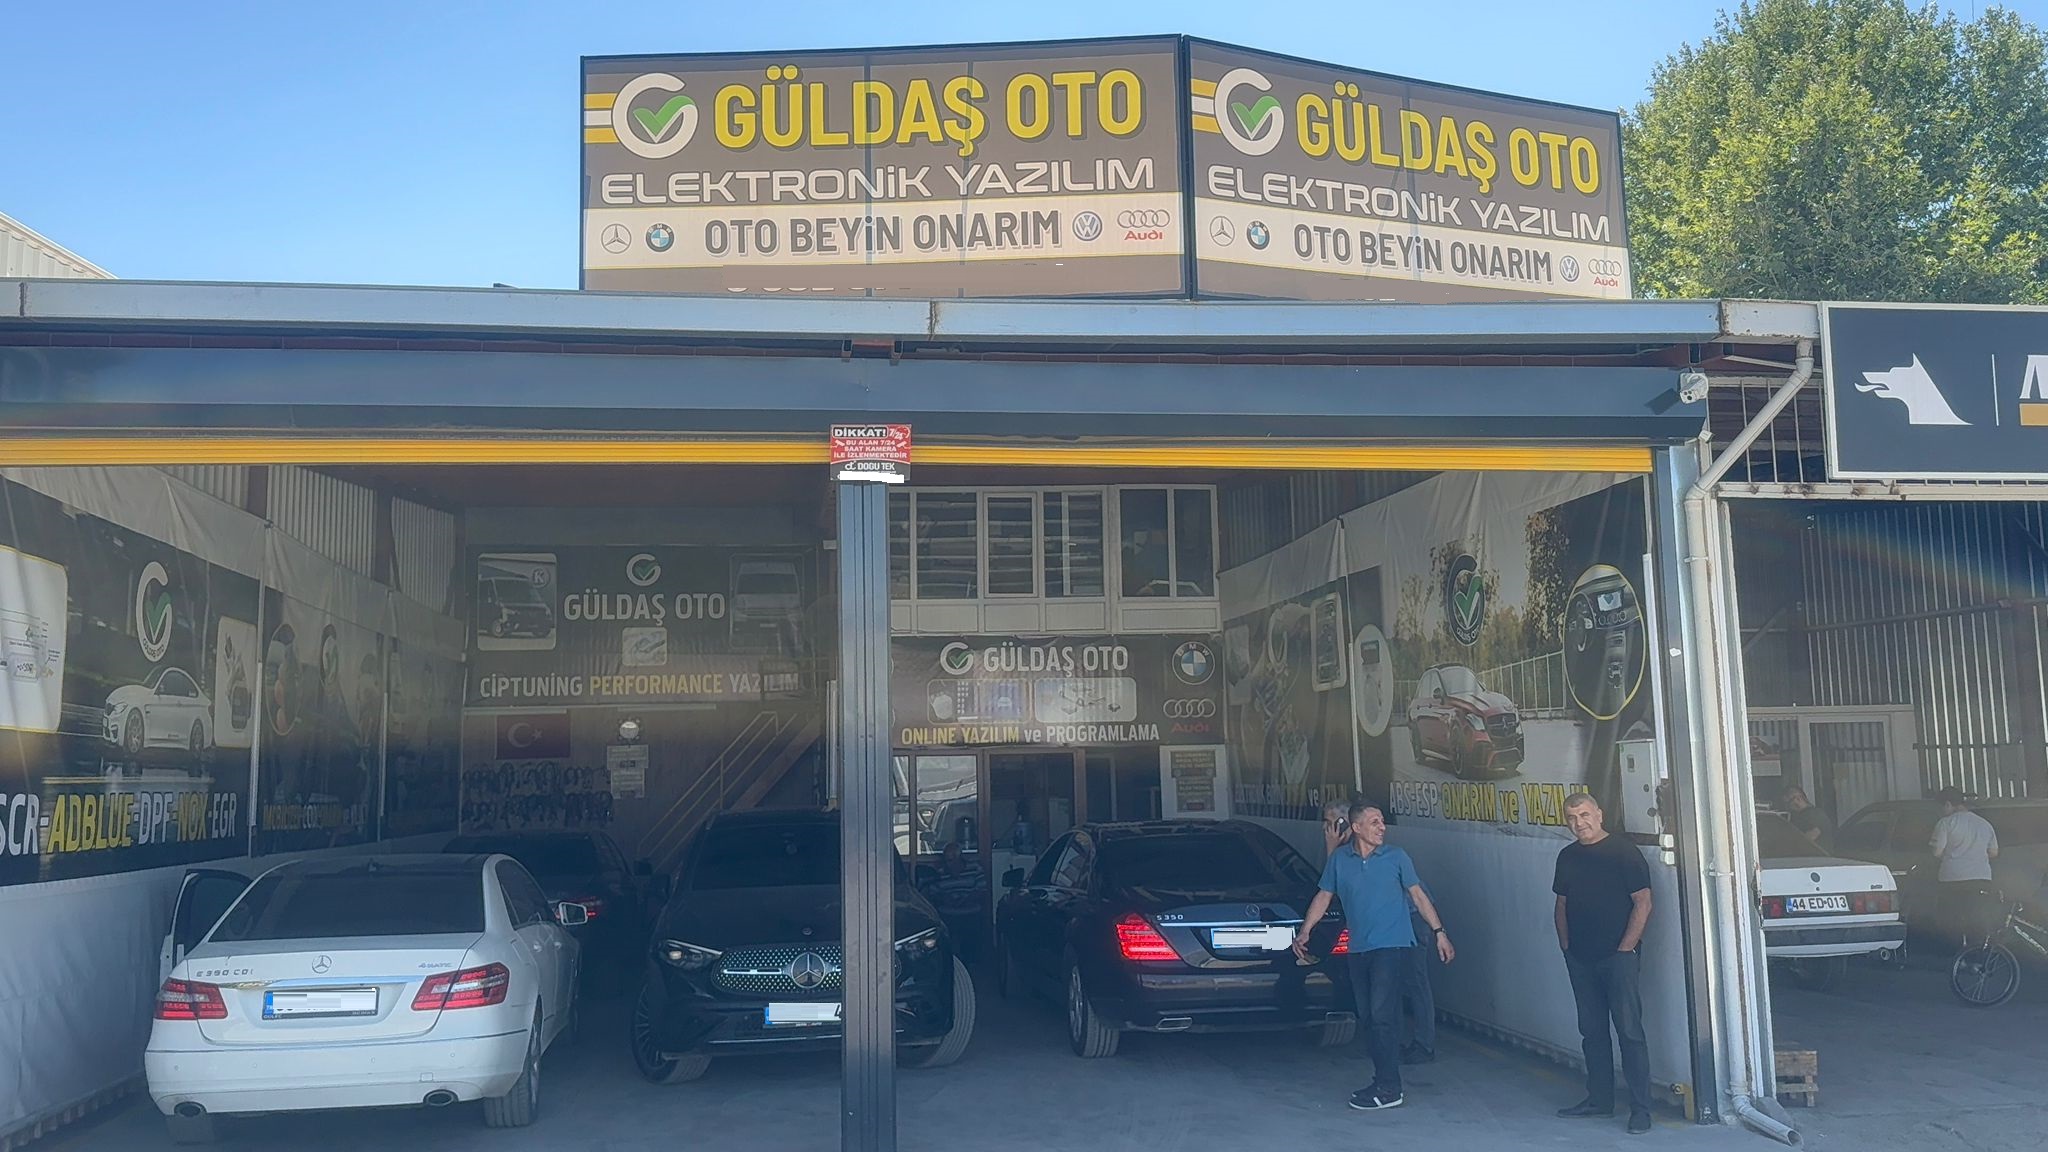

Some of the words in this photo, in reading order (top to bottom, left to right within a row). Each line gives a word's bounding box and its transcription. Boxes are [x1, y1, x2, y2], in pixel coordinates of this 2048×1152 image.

[714, 65, 986, 156] GÜLDAŞ
[1005, 69, 1143, 140] OTO
[1297, 80, 1497, 193] GÜLDAŞ
[1509, 127, 1599, 194] OTO
[945, 158, 1154, 197] YAZILIM
[704, 219, 778, 254] OTO
[912, 210, 1060, 248] ONARIM
[1124, 230, 1163, 241] Audi
[1470, 200, 1610, 242] YAZILIM
[1294, 224, 1351, 261] OTO
[1451, 241, 1552, 283] ONARIM
[1594, 276, 1618, 287] Audi
[834, 427, 886, 437] DİKKAT!
[881, 462, 895, 471] TEK
[564, 588, 665, 626] GÜLDAŞ
[675, 593, 726, 620] OTO
[983, 641, 1075, 677] GÜLDAŞ
[1083, 646, 1129, 671] OTO
[480, 672, 583, 698] CİPTUNİNG
[590, 674, 723, 696] PERFORMANCE
[902, 727, 956, 745] ONLINE
[961, 726, 1019, 744] YAZILIM
[1024, 730, 1041, 743] ve
[1046, 724, 1160, 743] PROGRAMLAMA
[1441, 783, 1497, 822] ONARIM
[1499, 789, 1519, 824] ve
[1521, 783, 1589, 826] YAZIL
[1792, 898, 1805, 910] 44
